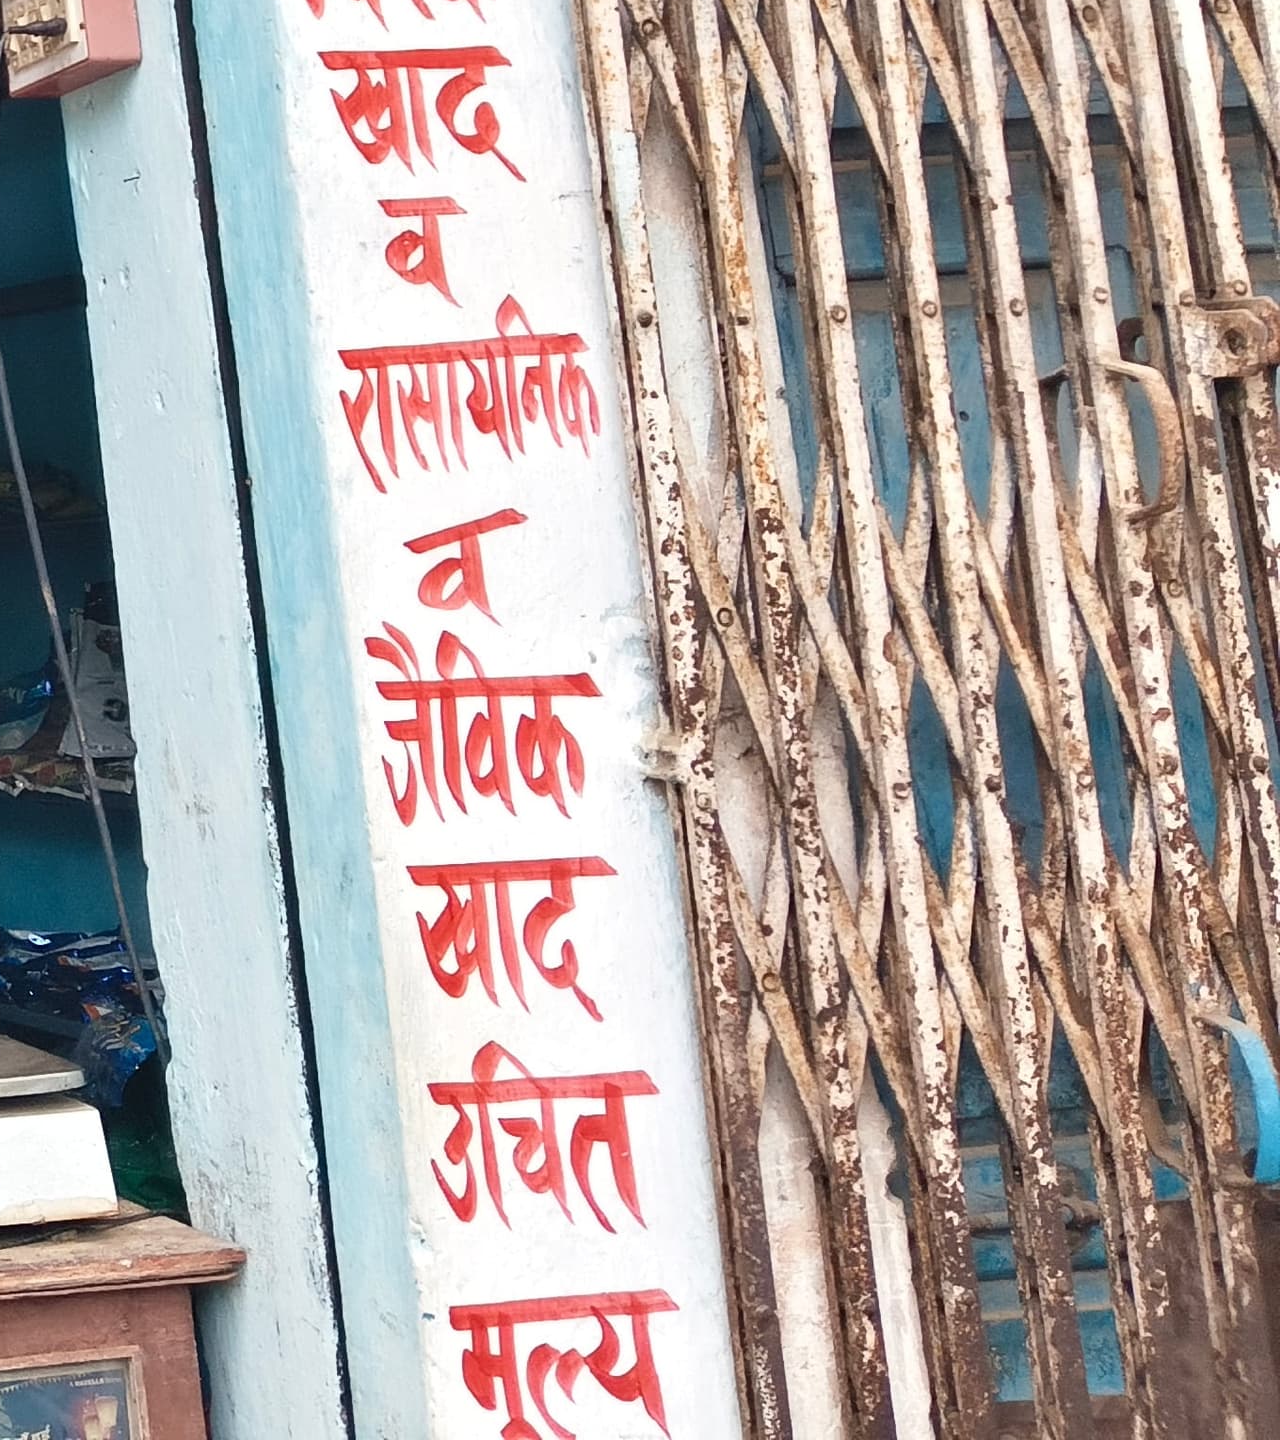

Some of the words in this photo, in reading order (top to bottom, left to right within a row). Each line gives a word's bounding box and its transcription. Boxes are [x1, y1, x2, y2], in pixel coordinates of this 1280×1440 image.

[316, 45, 528, 184] खाद
[377, 195, 468, 309] व
[338, 293, 602, 494] रासायनिक
[403, 507, 528, 627] व
[363, 620, 604, 827] जैविक
[405, 854, 618, 1023] खाद
[426, 1039, 661, 1236] उचित
